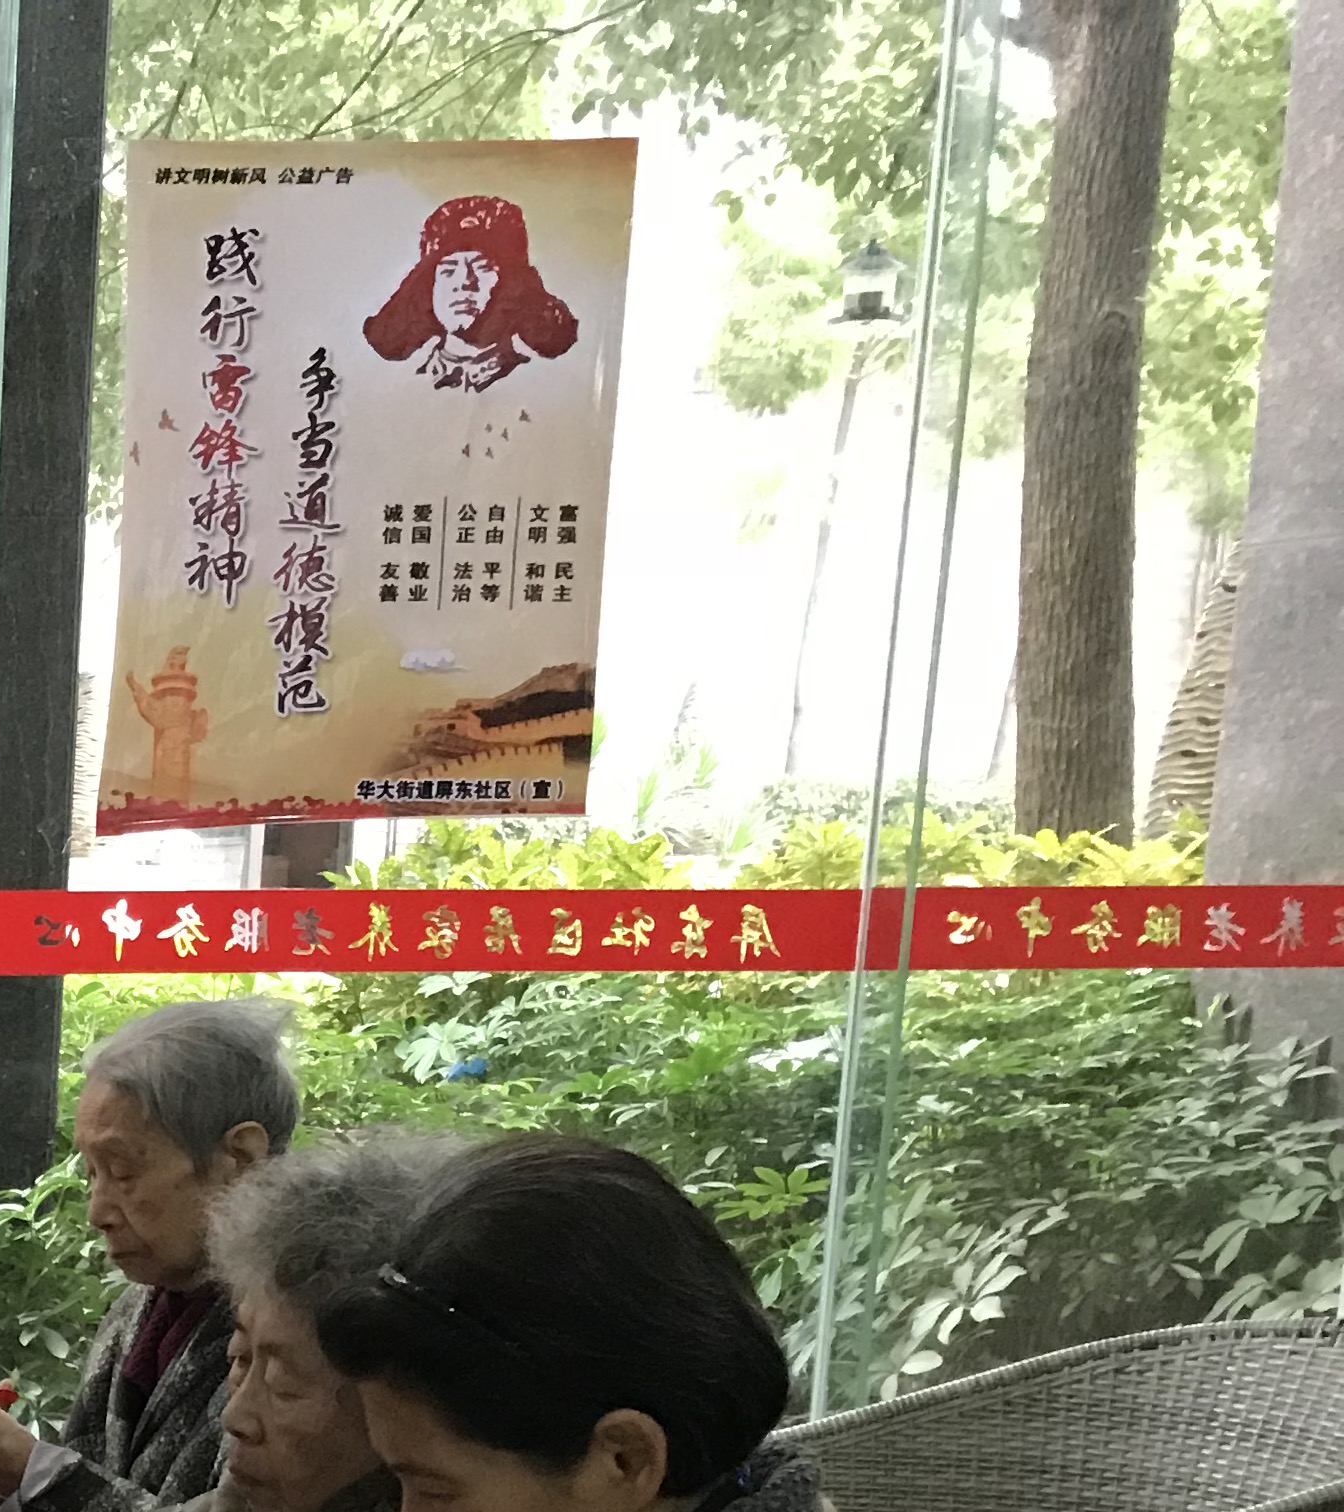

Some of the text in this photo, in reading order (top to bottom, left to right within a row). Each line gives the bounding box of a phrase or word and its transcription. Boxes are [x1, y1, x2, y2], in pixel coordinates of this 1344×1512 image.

[154, 166, 355, 186] 讲文明树新风 公益广告
[184, 226, 260, 605] 践行雷锋精神
[267, 346, 343, 714] 争当道德模范
